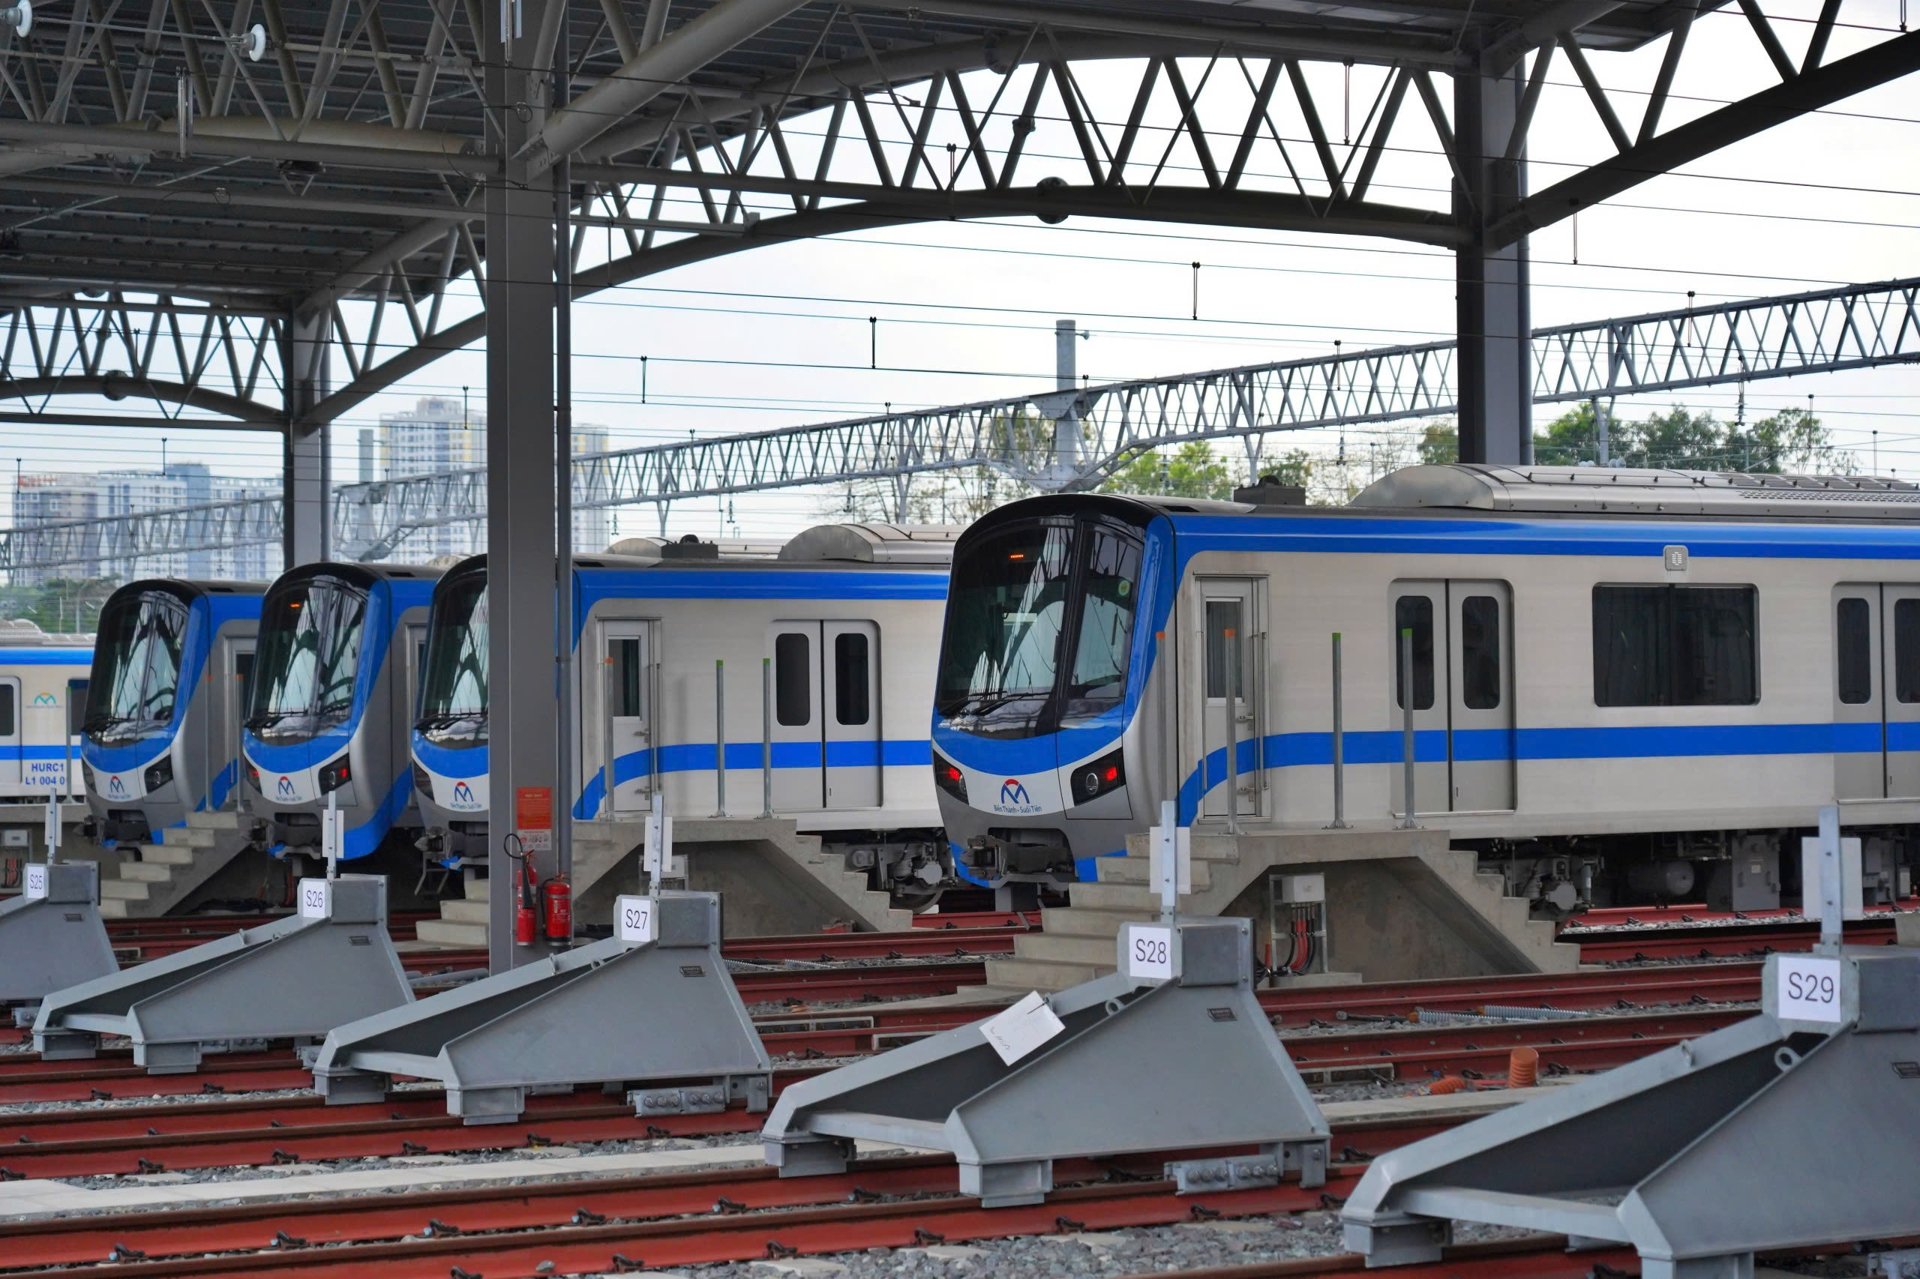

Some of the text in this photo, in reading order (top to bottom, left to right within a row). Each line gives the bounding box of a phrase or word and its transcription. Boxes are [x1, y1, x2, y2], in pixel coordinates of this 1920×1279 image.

[31, 762, 65, 772] HURC1
[25, 776, 36, 785] L1
[40, 776, 57, 785] 004
[30, 873, 43, 890] S25
[306, 889, 324, 908] S26
[625, 908, 648, 930] S27
[1135, 938, 1167, 964] S28
[1787, 971, 1834, 1004] S29
